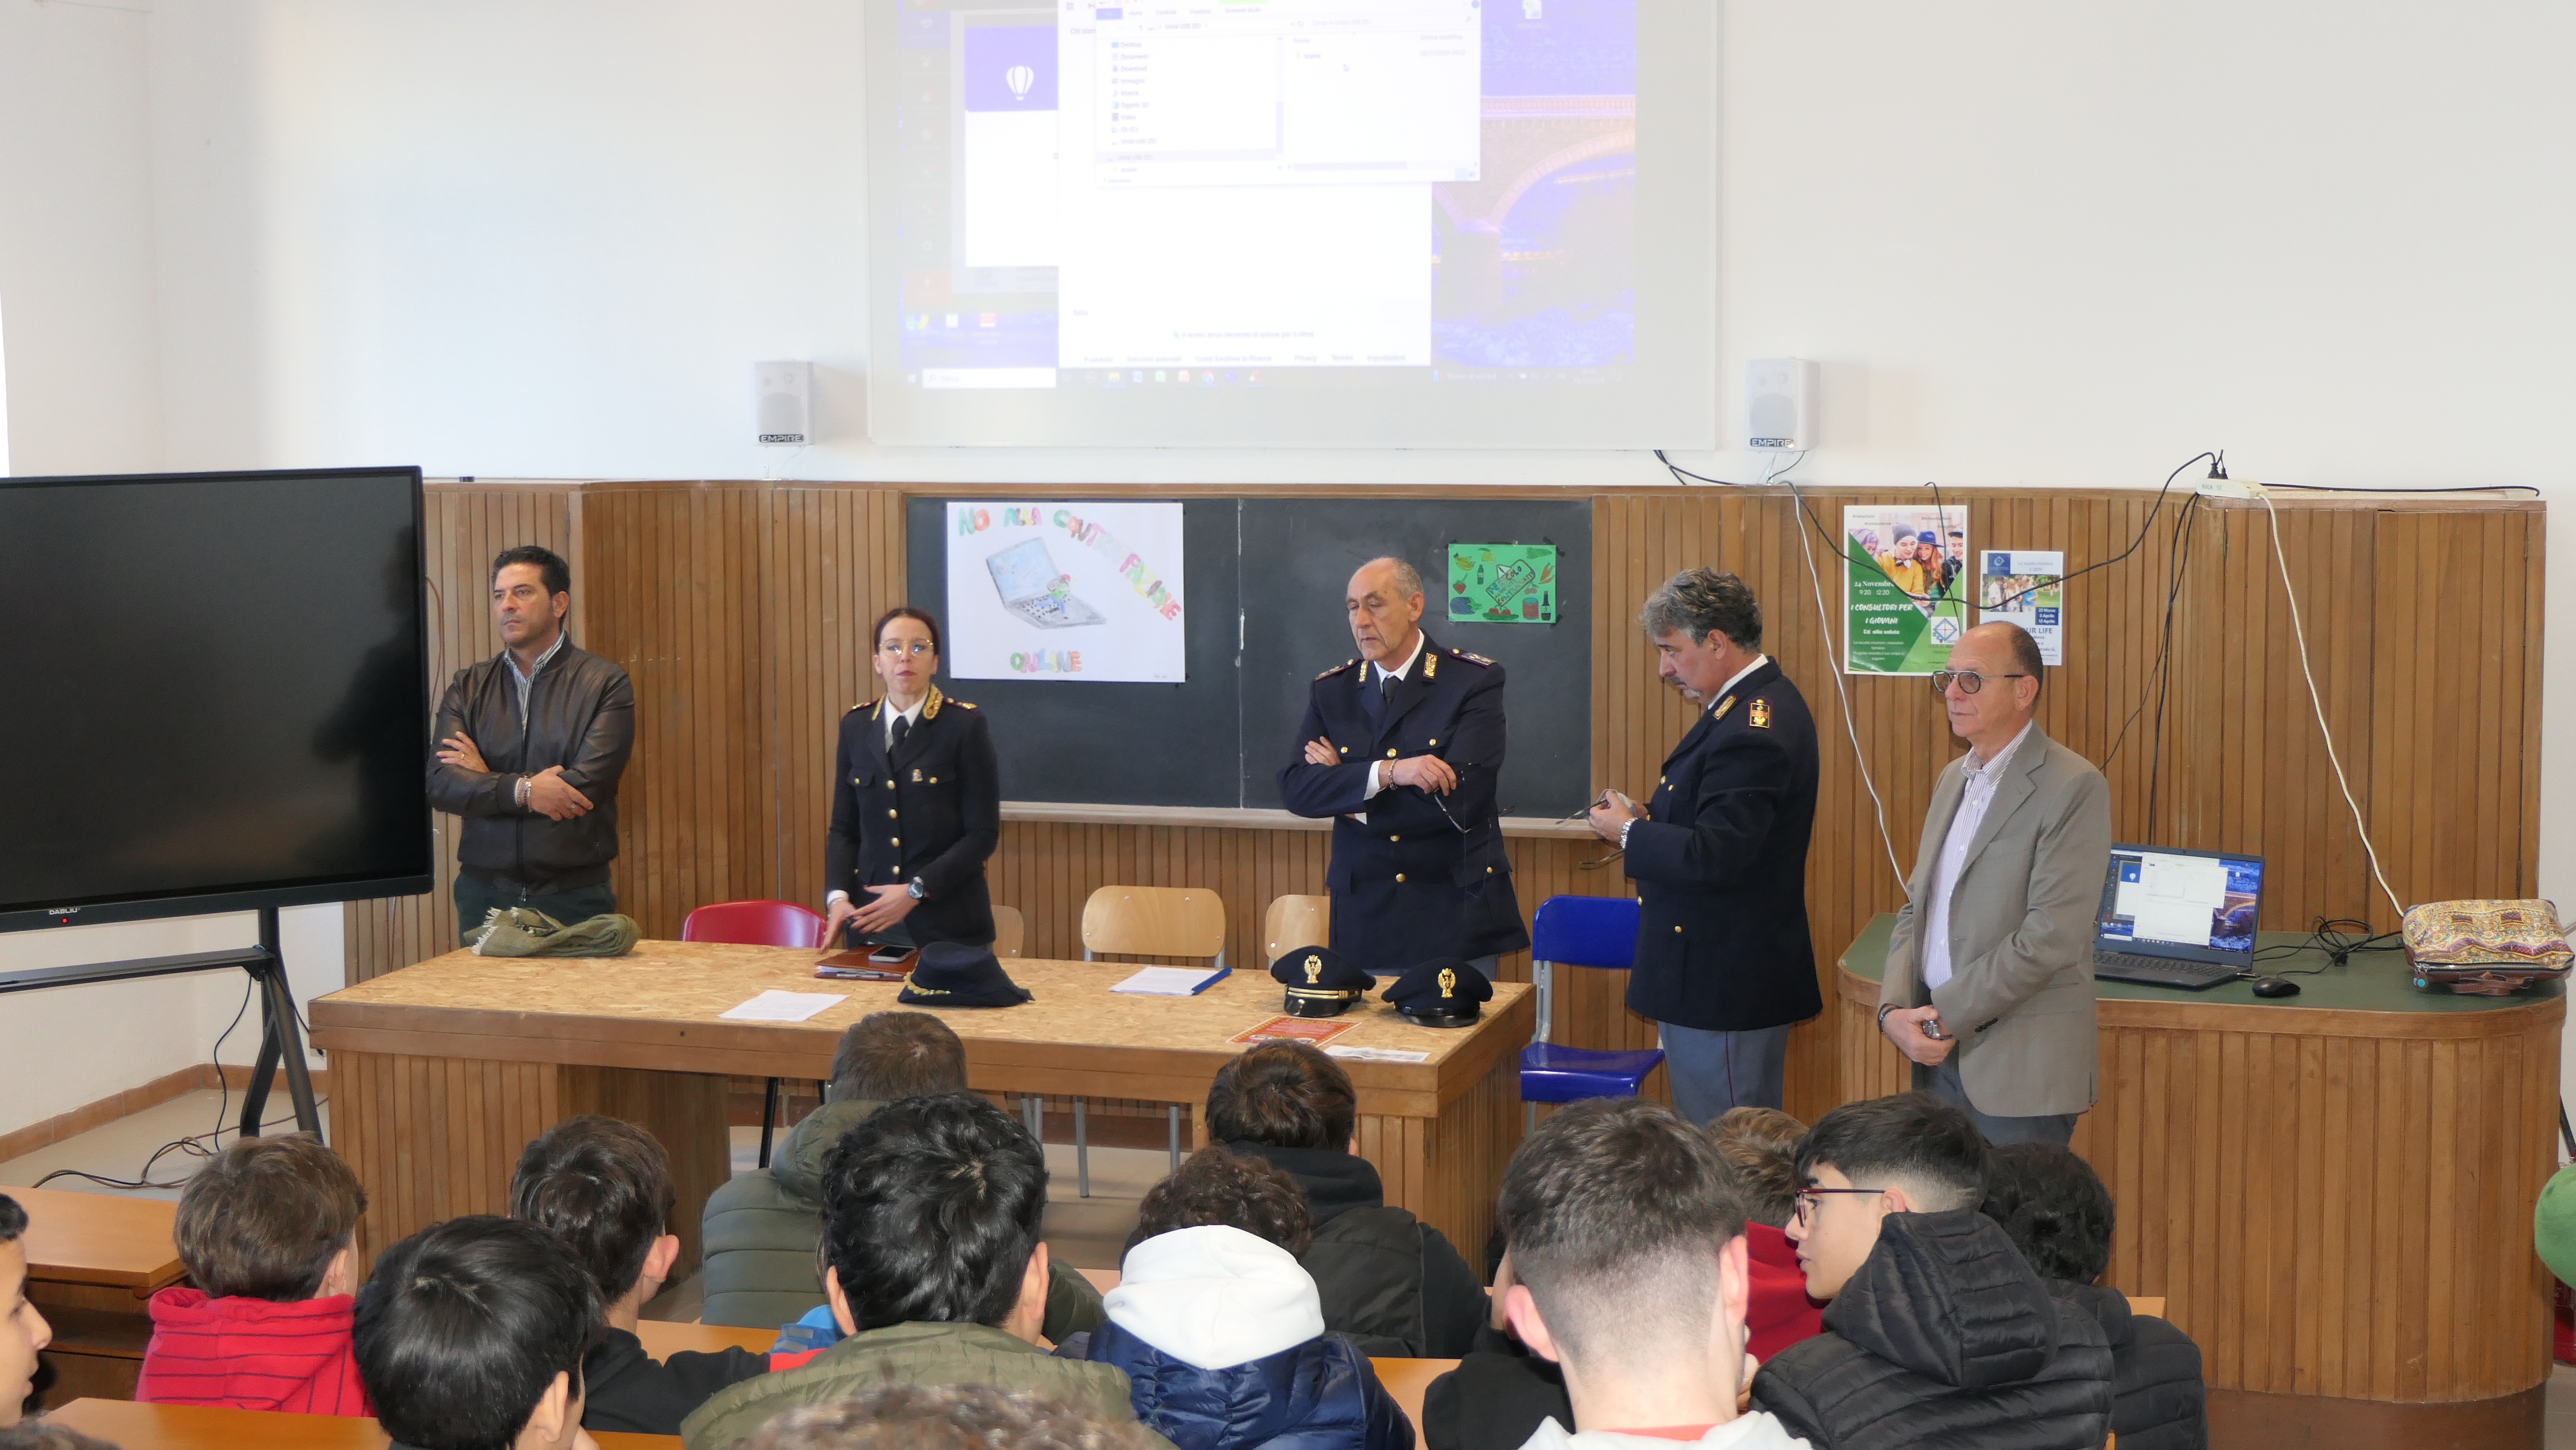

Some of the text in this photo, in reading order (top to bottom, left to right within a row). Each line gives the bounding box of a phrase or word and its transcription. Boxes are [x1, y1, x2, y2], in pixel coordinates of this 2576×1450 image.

[1295, 354, 1317, 362] Privacy
[1751, 439, 1792, 447] EMPIRE
[958, 508, 991, 536] NO
[1004, 507, 1043, 527] ALLA
[1010, 648, 1083, 673] ONLINE
